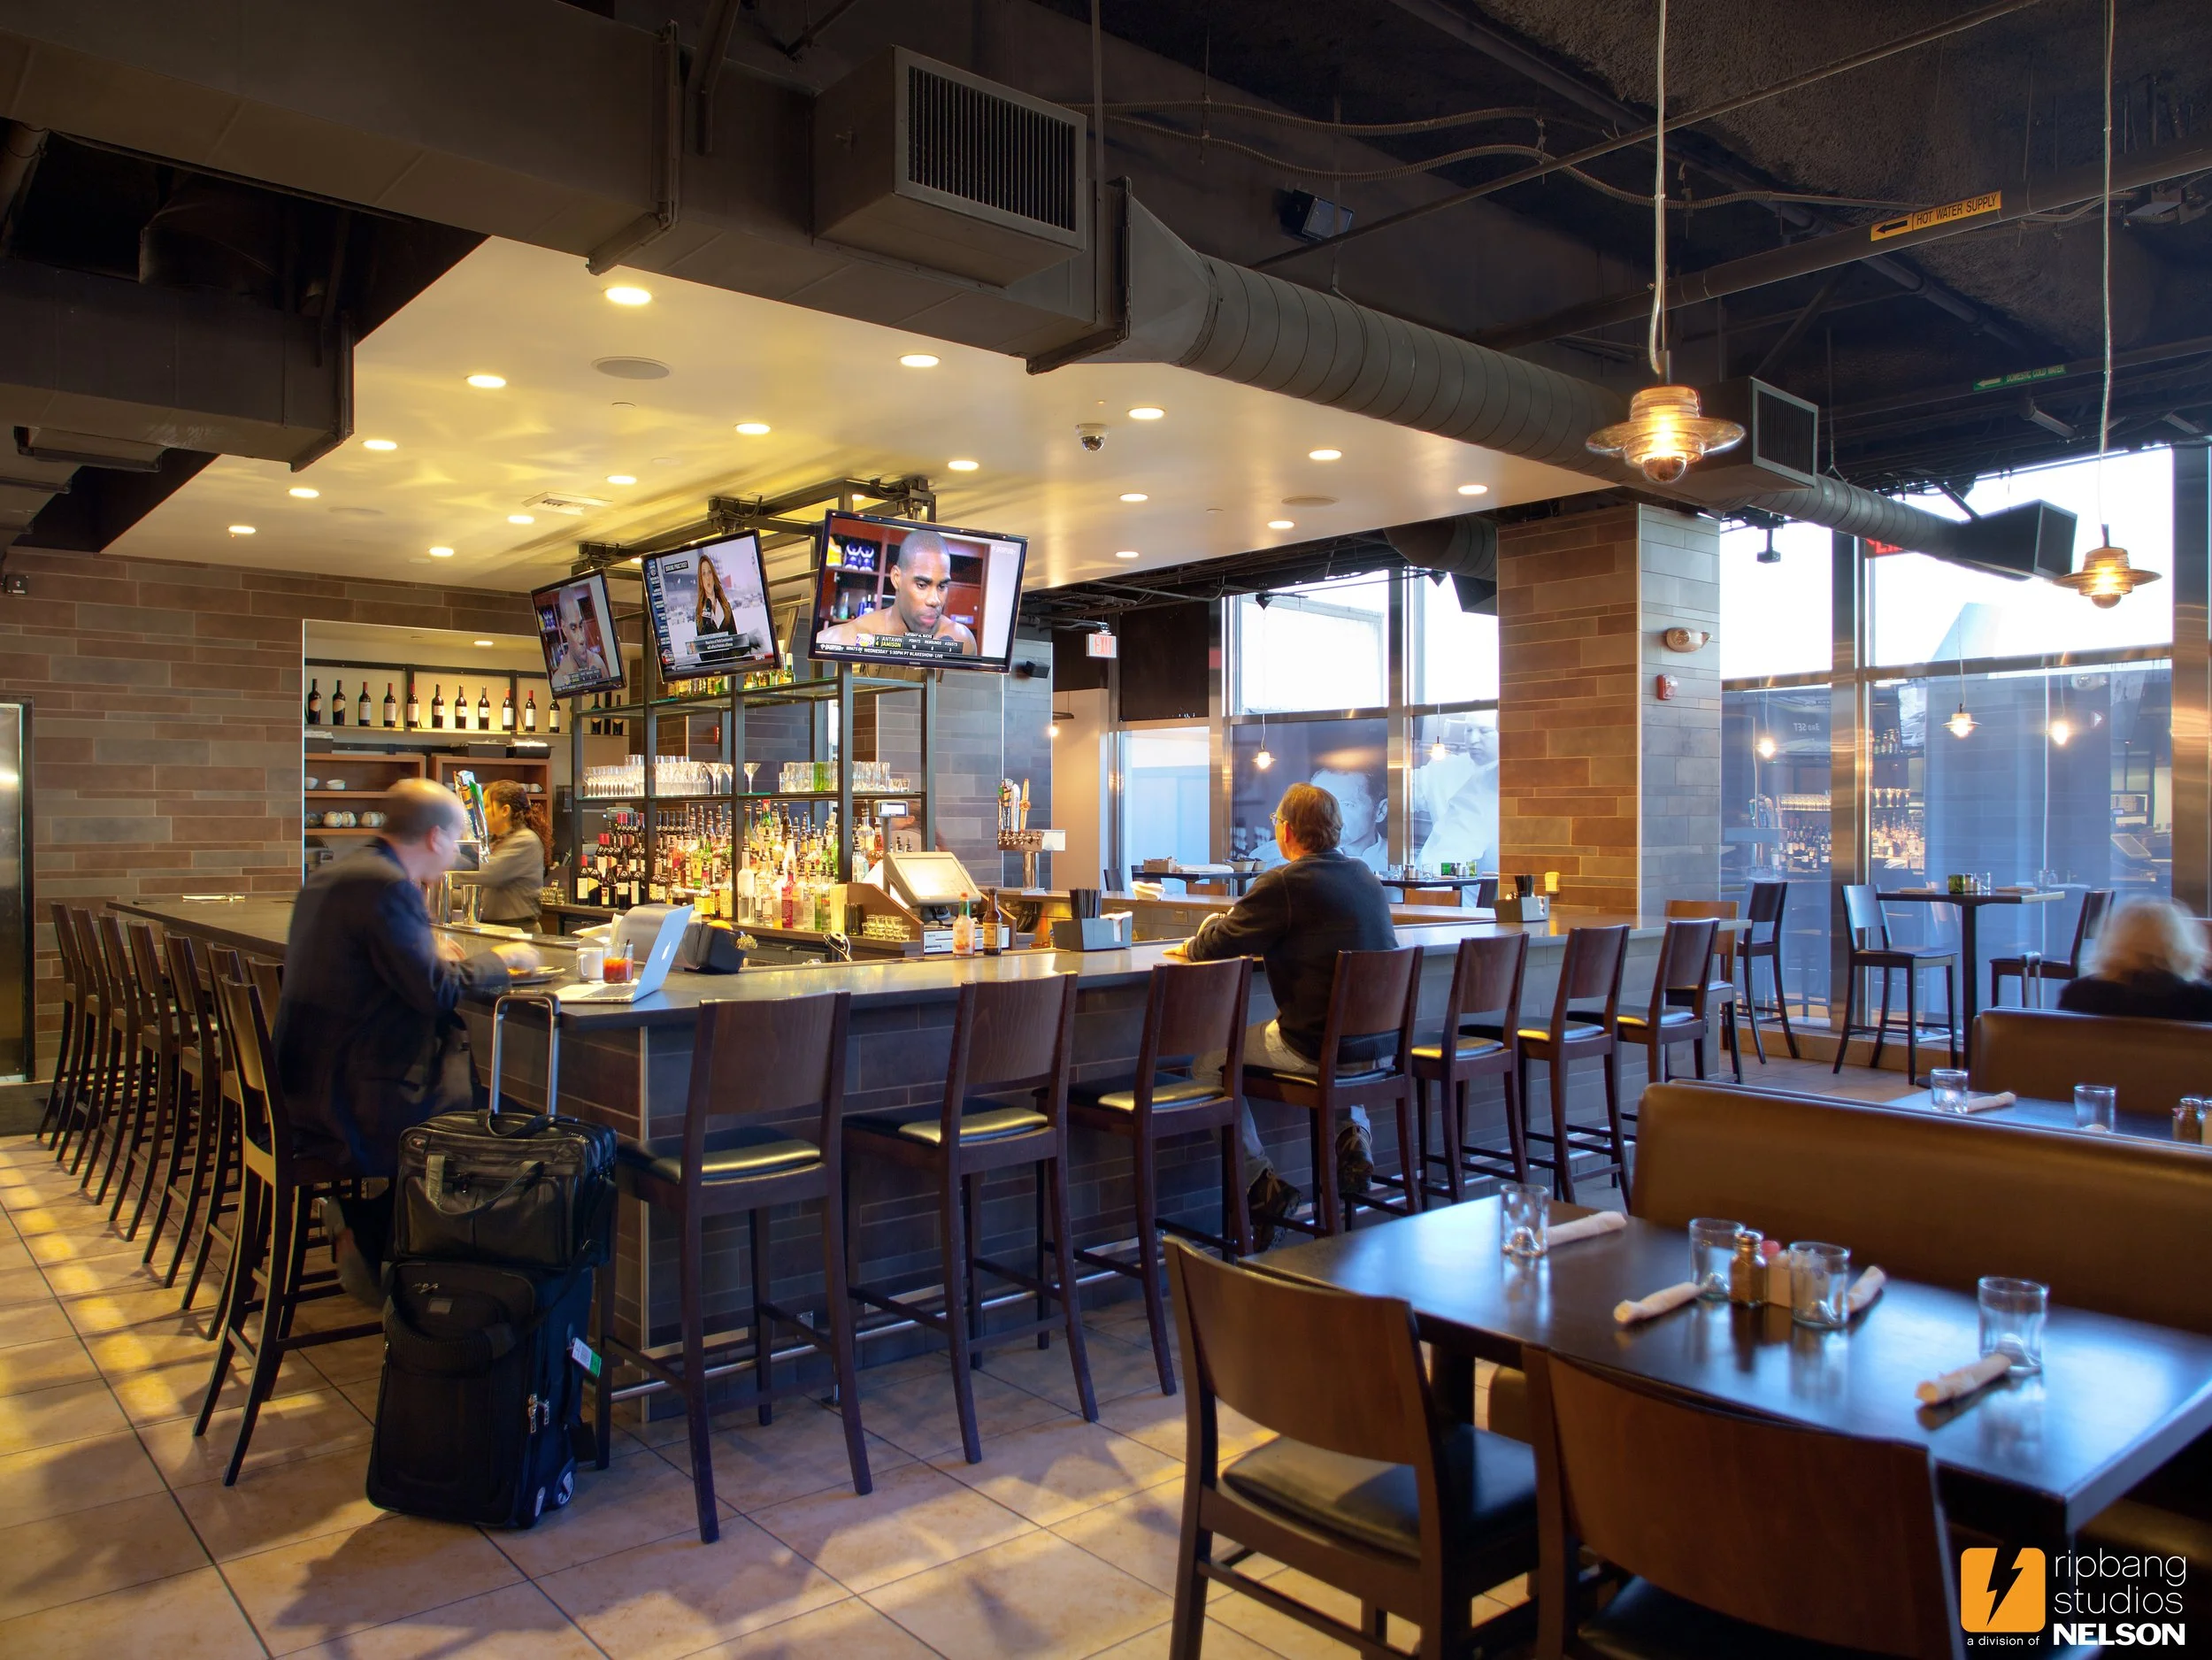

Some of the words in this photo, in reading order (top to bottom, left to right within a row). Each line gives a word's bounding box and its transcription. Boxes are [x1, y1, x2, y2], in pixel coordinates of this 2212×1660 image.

[1916, 212, 1932, 226] HOT
[1936, 203, 1962, 220] WATER
[1966, 194, 1997, 212] SUPPLY
[1094, 636, 1112, 656] EXIT
